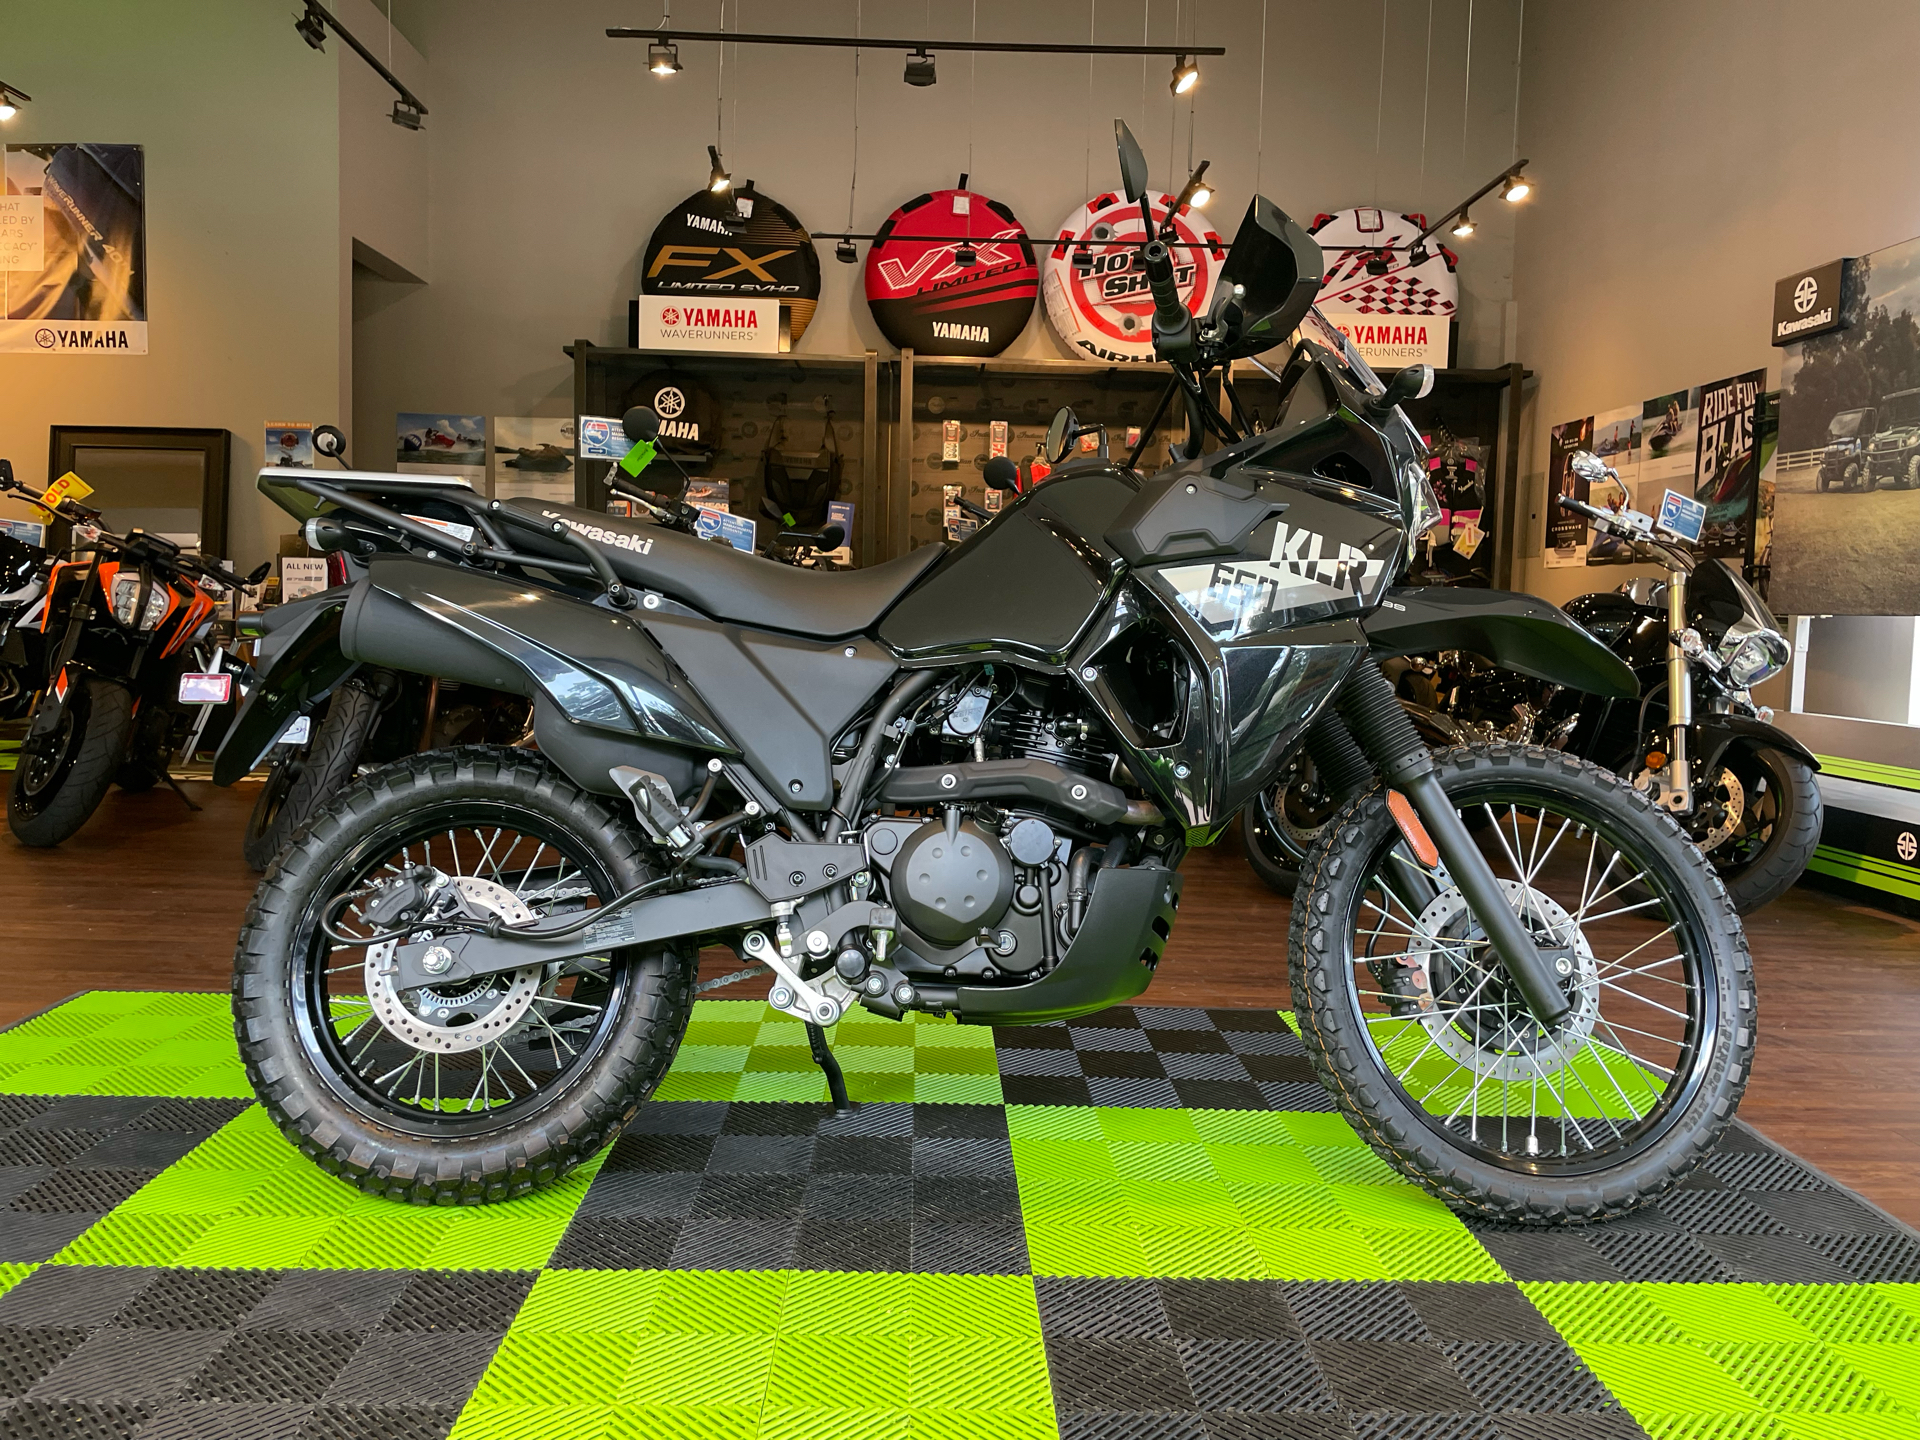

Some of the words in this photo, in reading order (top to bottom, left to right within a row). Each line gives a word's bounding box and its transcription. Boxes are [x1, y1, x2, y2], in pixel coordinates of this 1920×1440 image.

[0, 203, 20, 211] HAT
[48, 175, 103, 241] WAVERUNNER
[0, 215, 18, 225] ED
[21, 215, 35, 225] BY
[1, 229, 24, 238] ARS
[0, 255, 20, 264] NG
[647, 244, 797, 283] FX
[878, 228, 1021, 290] VX
[1079, 250, 1145, 280] HO
[657, 281, 736, 291] LIMITED
[738, 284, 801, 293] SVHO
[916, 261, 1021, 295] LIMITED
[1103, 265, 1196, 298] SHT
[683, 307, 758, 329] YAMAHA
[1777, 307, 1832, 337] Kawasaki
[57, 330, 129, 348] YAMAHA
[932, 321, 990, 343] YAMAHA
[1354, 325, 1428, 345] YAMAHA
[1076, 339, 1157, 363] AIRH
[1355, 347, 1423, 358] ERUNNERS
[1701, 385, 1736, 427] RIDE
[657, 419, 699, 441] MAHA
[1695, 407, 1755, 492] BLAS
[44, 478, 71, 505] OLD
[286, 562, 301, 570] ALL
[1269, 520, 1368, 599] KLR
[1381, 599, 1406, 612] BS
